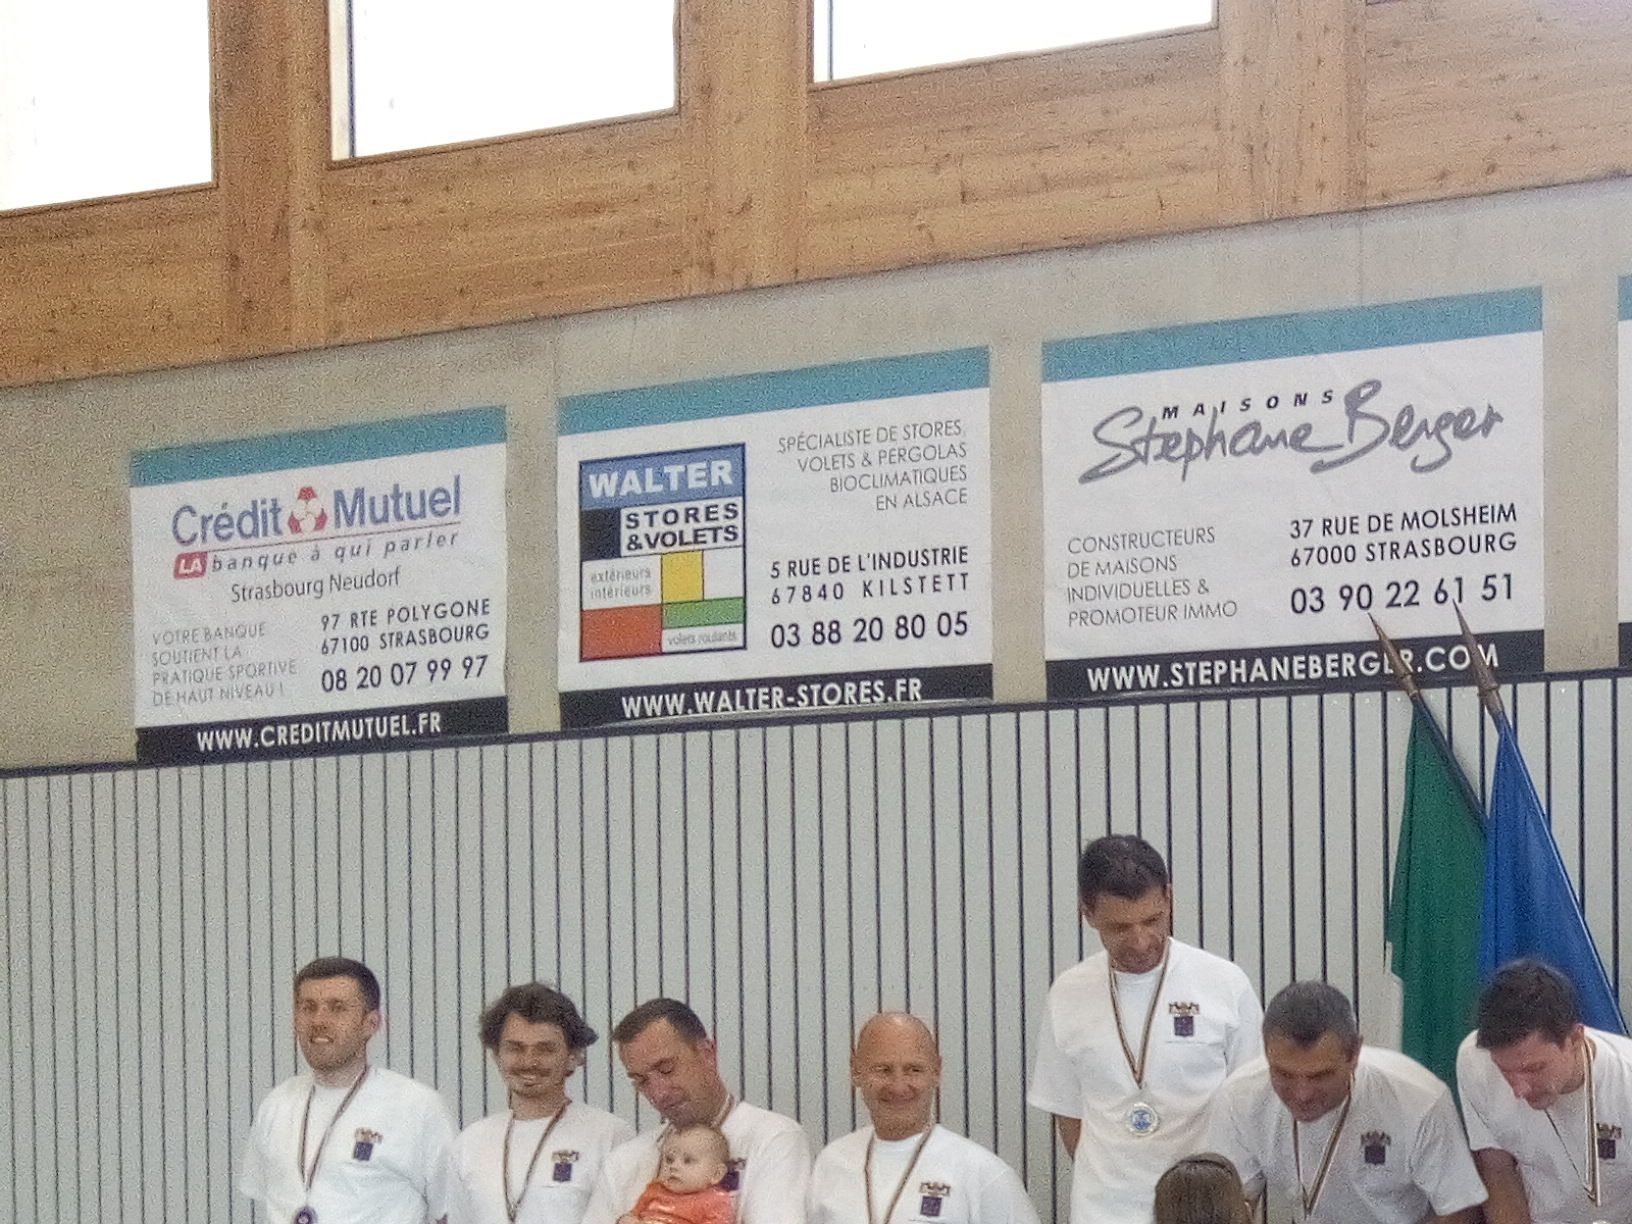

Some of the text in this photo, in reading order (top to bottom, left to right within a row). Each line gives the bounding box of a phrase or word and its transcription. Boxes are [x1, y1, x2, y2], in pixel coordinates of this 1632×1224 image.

[1161, 389, 1334, 420] MAISONS
[777, 428, 872, 454] SPÉCIALISTE
[876, 425, 898, 443] DE
[1078, 379, 1504, 485] Stephane Berger
[797, 442, 967, 473] VOLETS & PERGOLAS
[588, 458, 733, 499] WALTER
[830, 465, 967, 493] BIOCLIMATIQUES
[172, 475, 461, 547] Crédit Mutuel
[876, 487, 968, 511] EN ALSACE
[625, 502, 739, 530] STORES
[1289, 502, 1518, 540] 37 RUE DE MOLSHEIM
[179, 531, 460, 577] LA banque à qui parler
[1068, 525, 1216, 554] CONSTRUCTEURS
[1290, 531, 1518, 568] 67000 STRASBOURG
[590, 567, 651, 584] extérieurs
[770, 546, 969, 579] 5 RUE DE L'INDUSTRIE
[1068, 554, 1177, 579] DE MAISONS
[231, 567, 401, 603] Strasbourg Neudorf
[590, 583, 651, 601] intérieurs
[770, 573, 969, 605] 67840 KILSTETT
[1067, 577, 1210, 604] INDIVIDUELLES &
[1290, 573, 1513, 616] 03 90 22 61 51
[320, 598, 491, 632] 97 RTE POLYGONE
[770, 611, 968, 649] 03 88 20 80 05
[1068, 601, 1238, 628] PROMOTEUR IMMO
[152, 622, 266, 646] VOTRE BANQUE
[320, 624, 490, 655] 67100 STRASBOURG
[152, 645, 242, 667] SOUTIENT LA
[153, 658, 297, 686] PRATIQUE SPORTIVE
[321, 655, 489, 693] 08 20 07 99 97
[153, 690, 172, 706] DE
[176, 688, 213, 704] HAUT
[220, 683, 274, 700] NIVEAU
[621, 677, 922, 718] WWW.WALTER-STORES.FR
[197, 711, 441, 752] WWW.CREDITMUTUEL.FR
